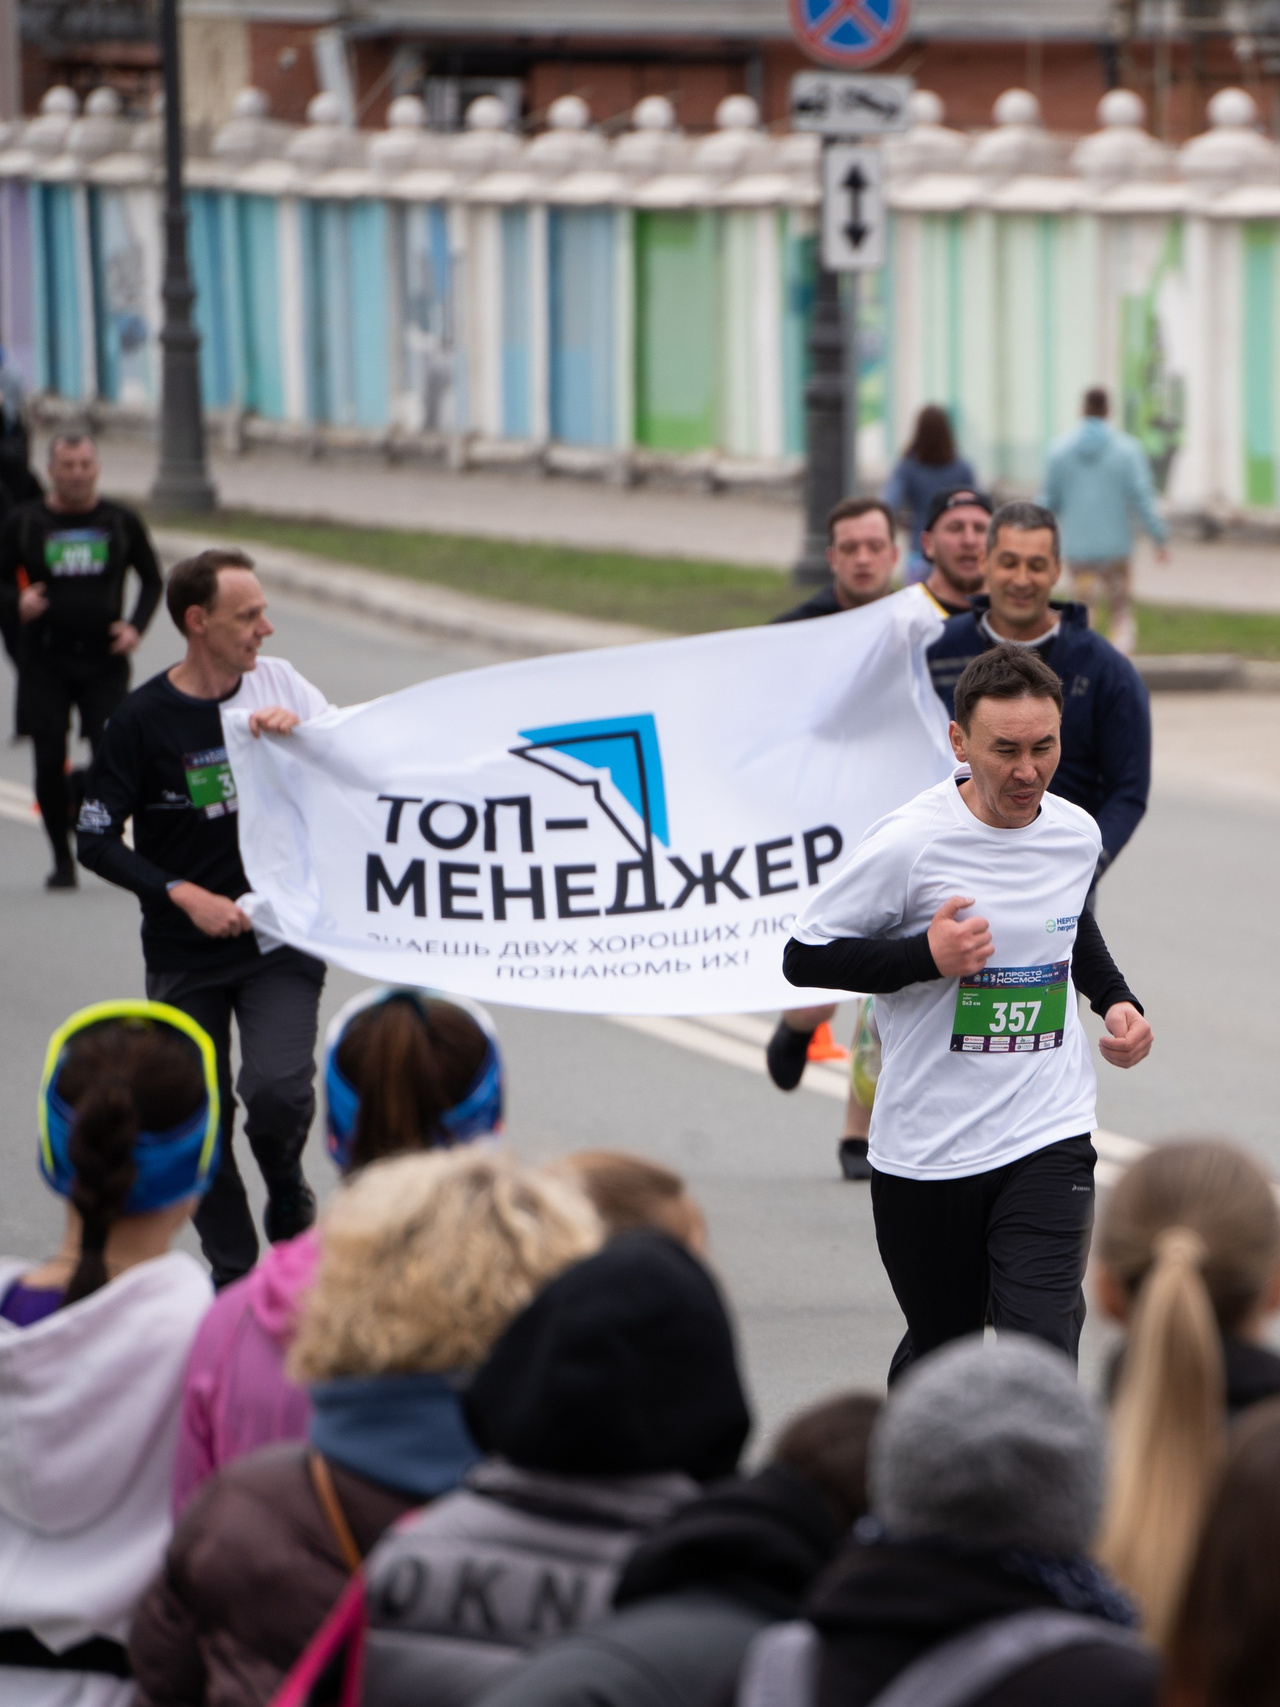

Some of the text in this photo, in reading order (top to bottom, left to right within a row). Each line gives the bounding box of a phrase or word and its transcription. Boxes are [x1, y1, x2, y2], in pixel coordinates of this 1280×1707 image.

[217, 773, 236, 798] 3
[366, 823, 844, 921] МЕНЕДЖЕР
[499, 938, 578, 960] ДВУХ
[587, 922, 741, 955] ХОРОШИХ
[749, 912, 798, 938] ЛЮ
[496, 950, 750, 980] ПОЗНАКОМЬ ИХ!
[996, 976, 1042, 984] КОСМОС
[989, 1001, 1042, 1033] 357
